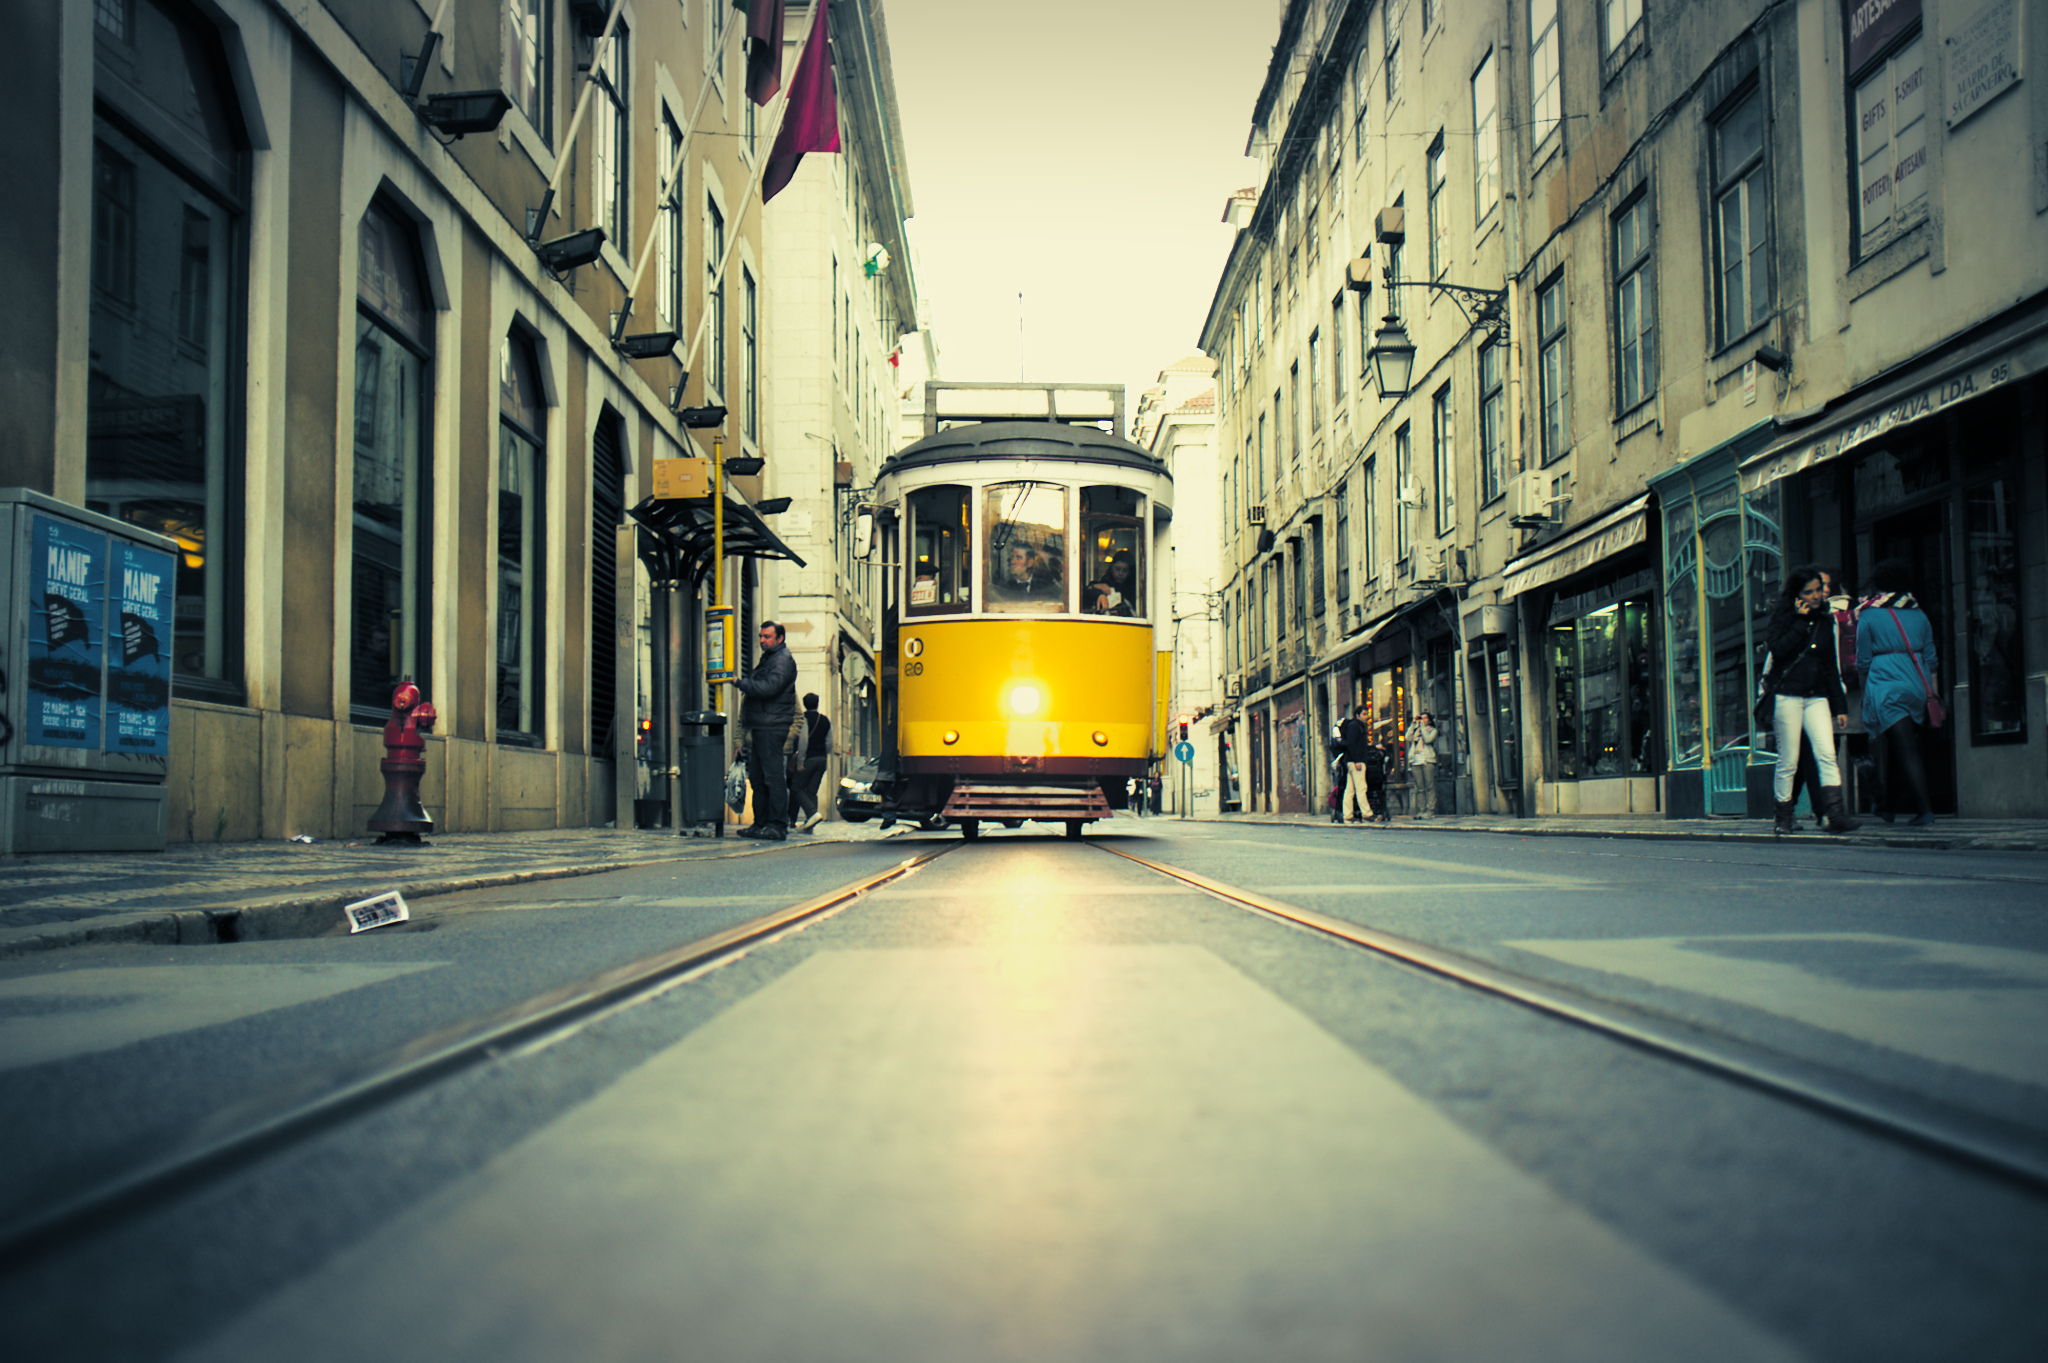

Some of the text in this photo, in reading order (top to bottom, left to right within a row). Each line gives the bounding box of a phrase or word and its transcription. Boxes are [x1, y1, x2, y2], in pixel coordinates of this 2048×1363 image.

[1895, 67, 1924, 105] T-SHIRT
[1863, 99, 1886, 133] GIFTS
[1815, 444, 1827, 460] 93
[1861, 415, 1880, 437] DA
[1940, 374, 1979, 406] LDA.
[1991, 364, 2008, 385] 95
[47, 545, 91, 587] MANIF
[46, 581, 89, 603] GREVE GERAL
[123, 568, 161, 605] MANIF
[122, 600, 159, 621] GREVE GERAL
[42, 701, 51, 714] 22
[119, 712, 126, 723] 22
